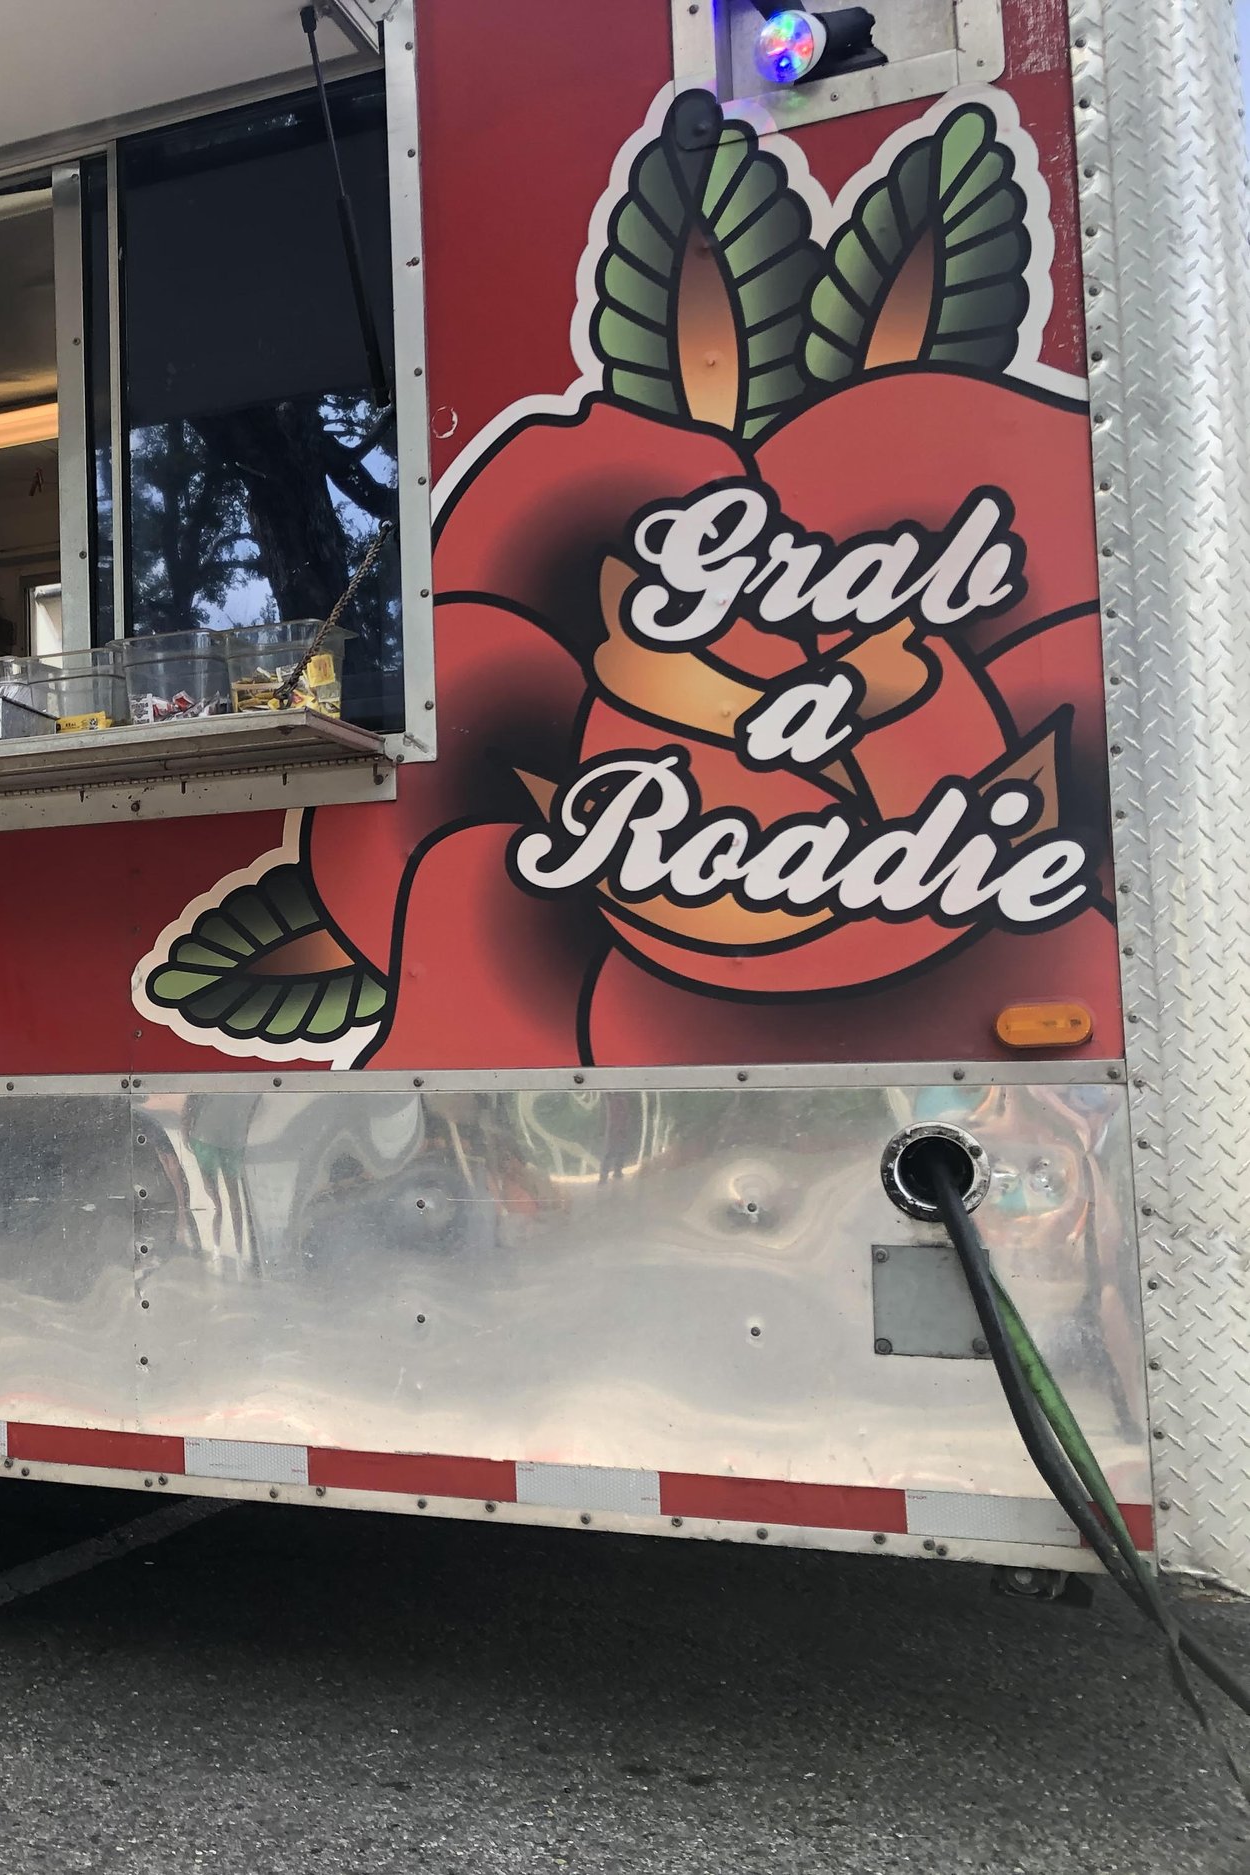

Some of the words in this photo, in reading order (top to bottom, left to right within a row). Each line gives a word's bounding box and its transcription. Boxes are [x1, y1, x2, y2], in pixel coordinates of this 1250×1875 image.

[630, 486, 1014, 642] Grab
[746, 673, 853, 763] a
[516, 755, 1088, 923] Roadie
